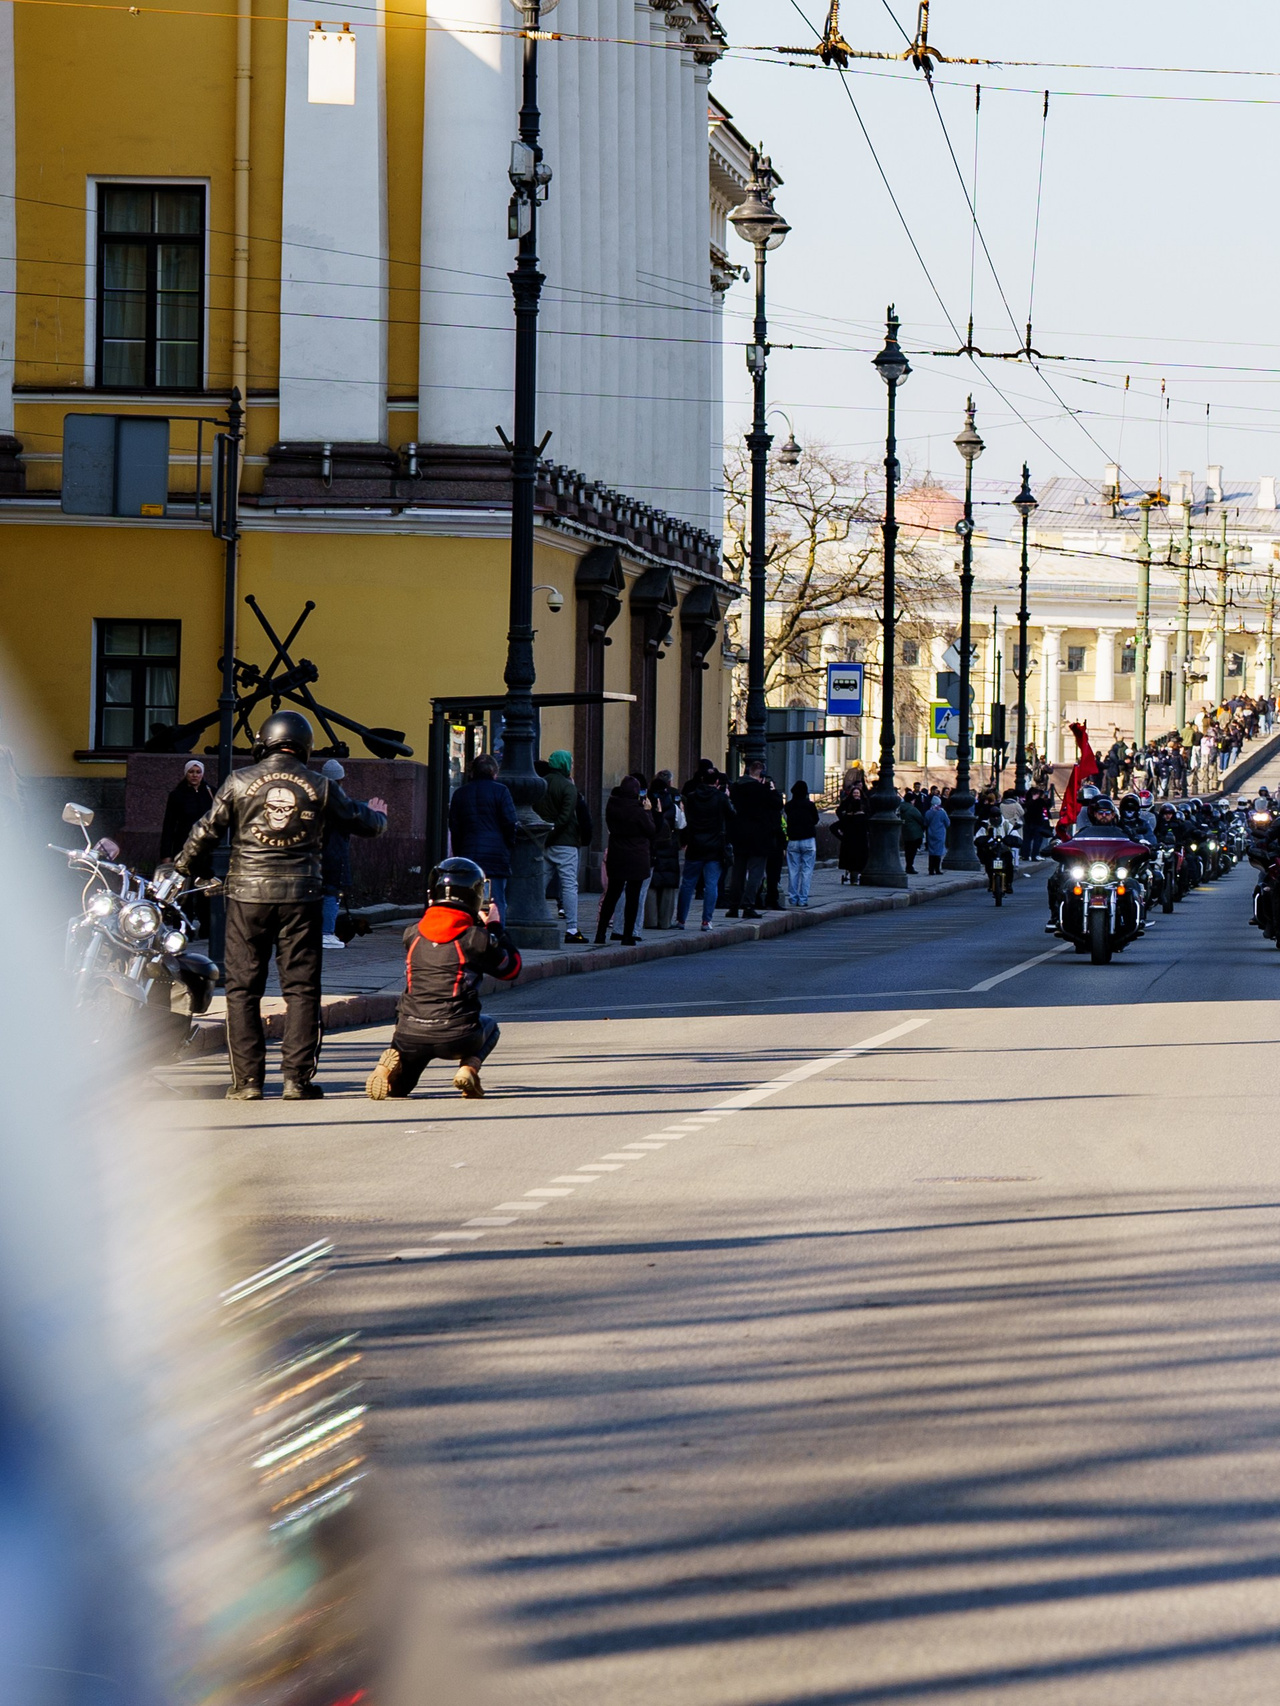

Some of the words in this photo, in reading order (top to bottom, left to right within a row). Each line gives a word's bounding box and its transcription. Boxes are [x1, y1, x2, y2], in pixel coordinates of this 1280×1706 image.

[246, 778, 264, 797] THE
[264, 772, 319, 802] HOOLIGANS
[250, 826, 307, 847] GATCHINA
